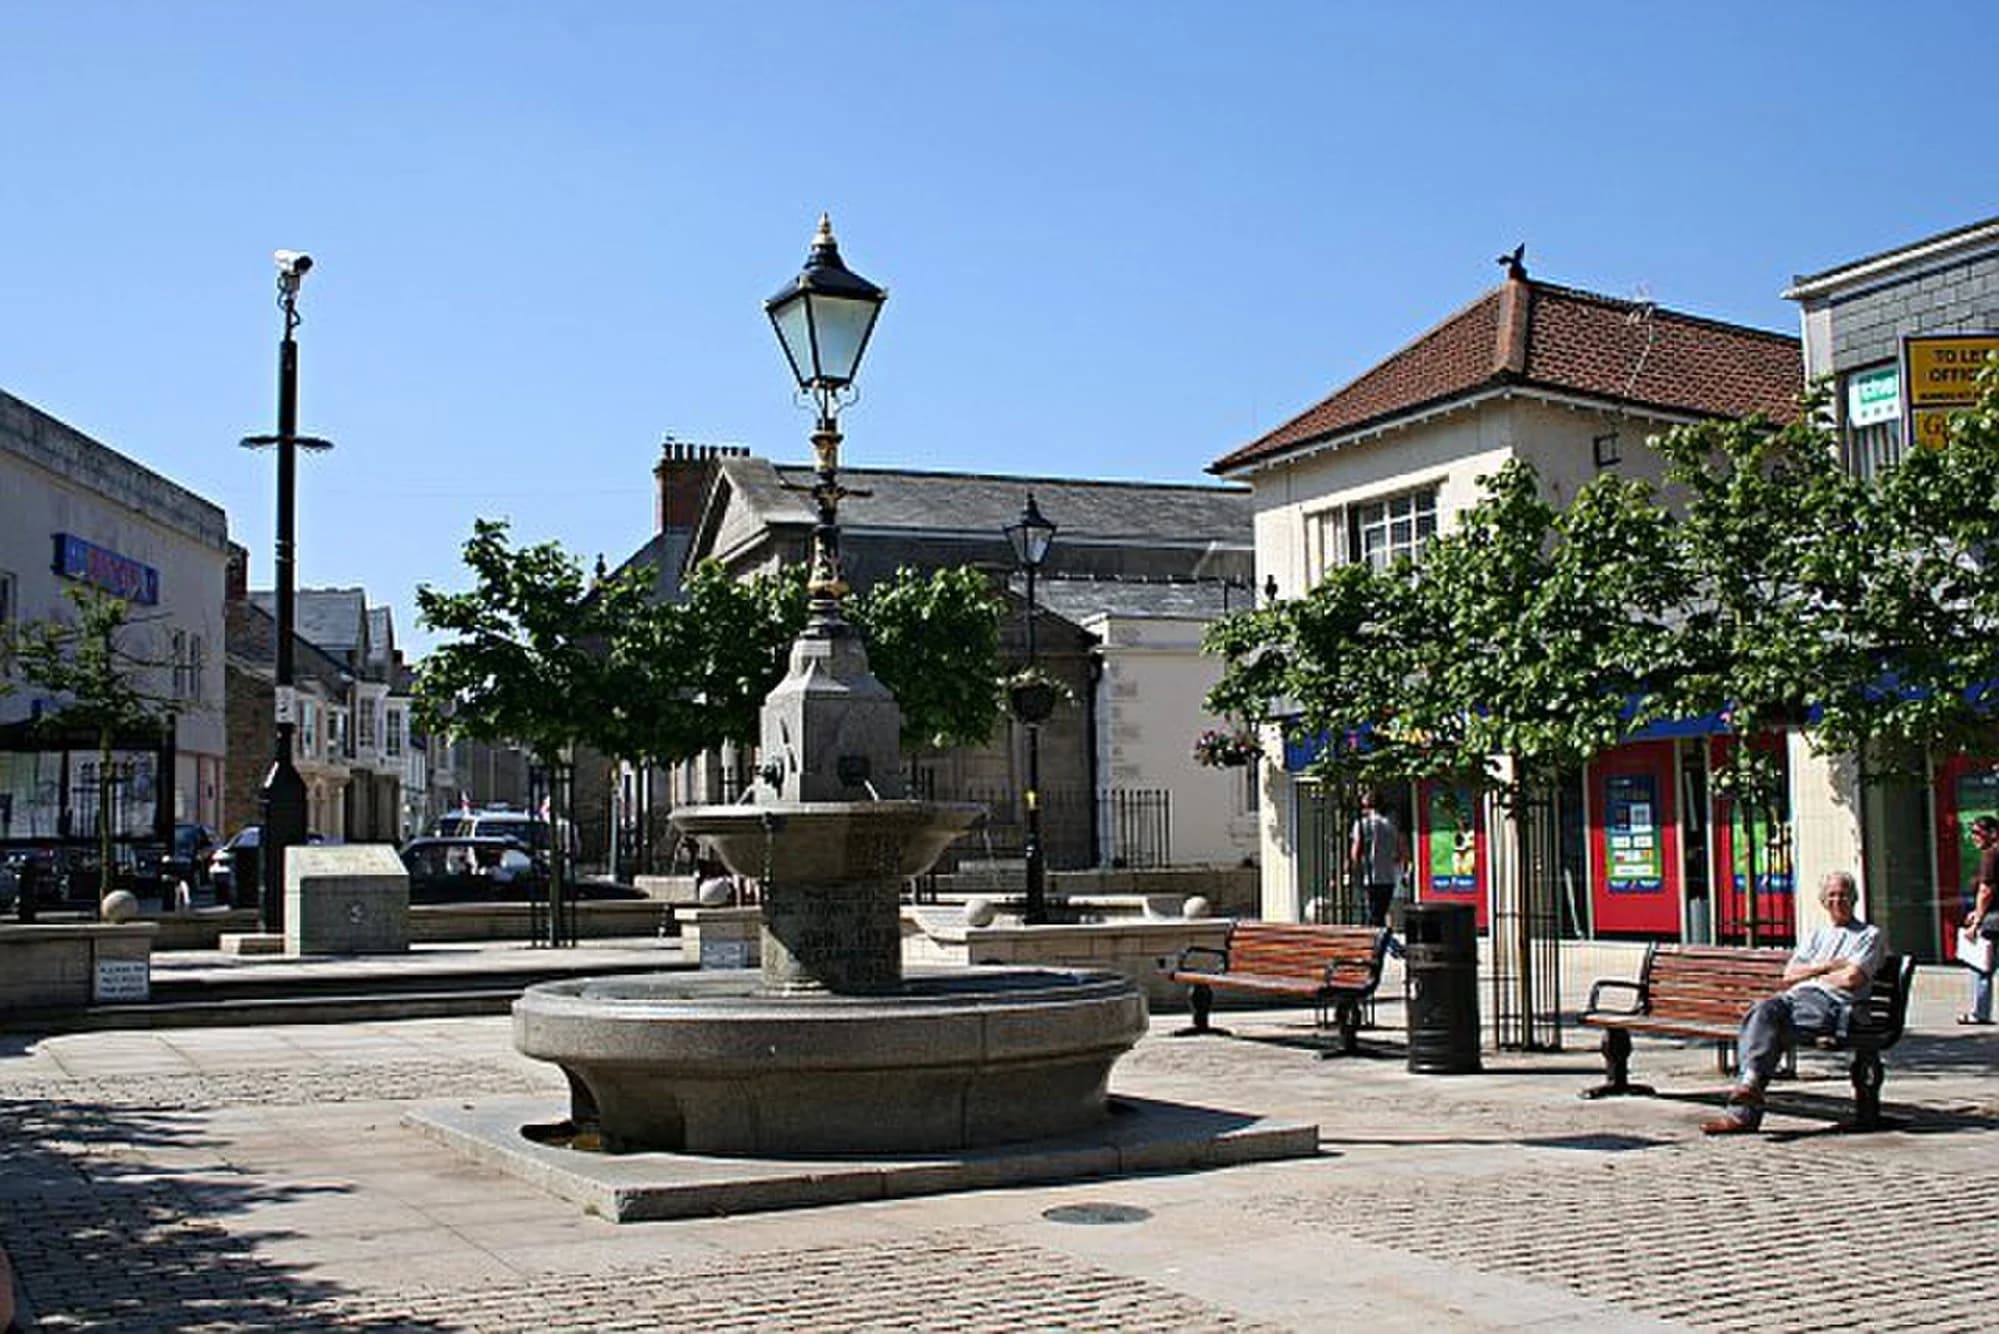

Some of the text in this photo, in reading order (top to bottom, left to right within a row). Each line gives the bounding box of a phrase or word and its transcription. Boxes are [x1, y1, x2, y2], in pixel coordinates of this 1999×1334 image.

[1934, 350, 1989, 363] TO LET
[1929, 367, 1981, 382] OFFIC
